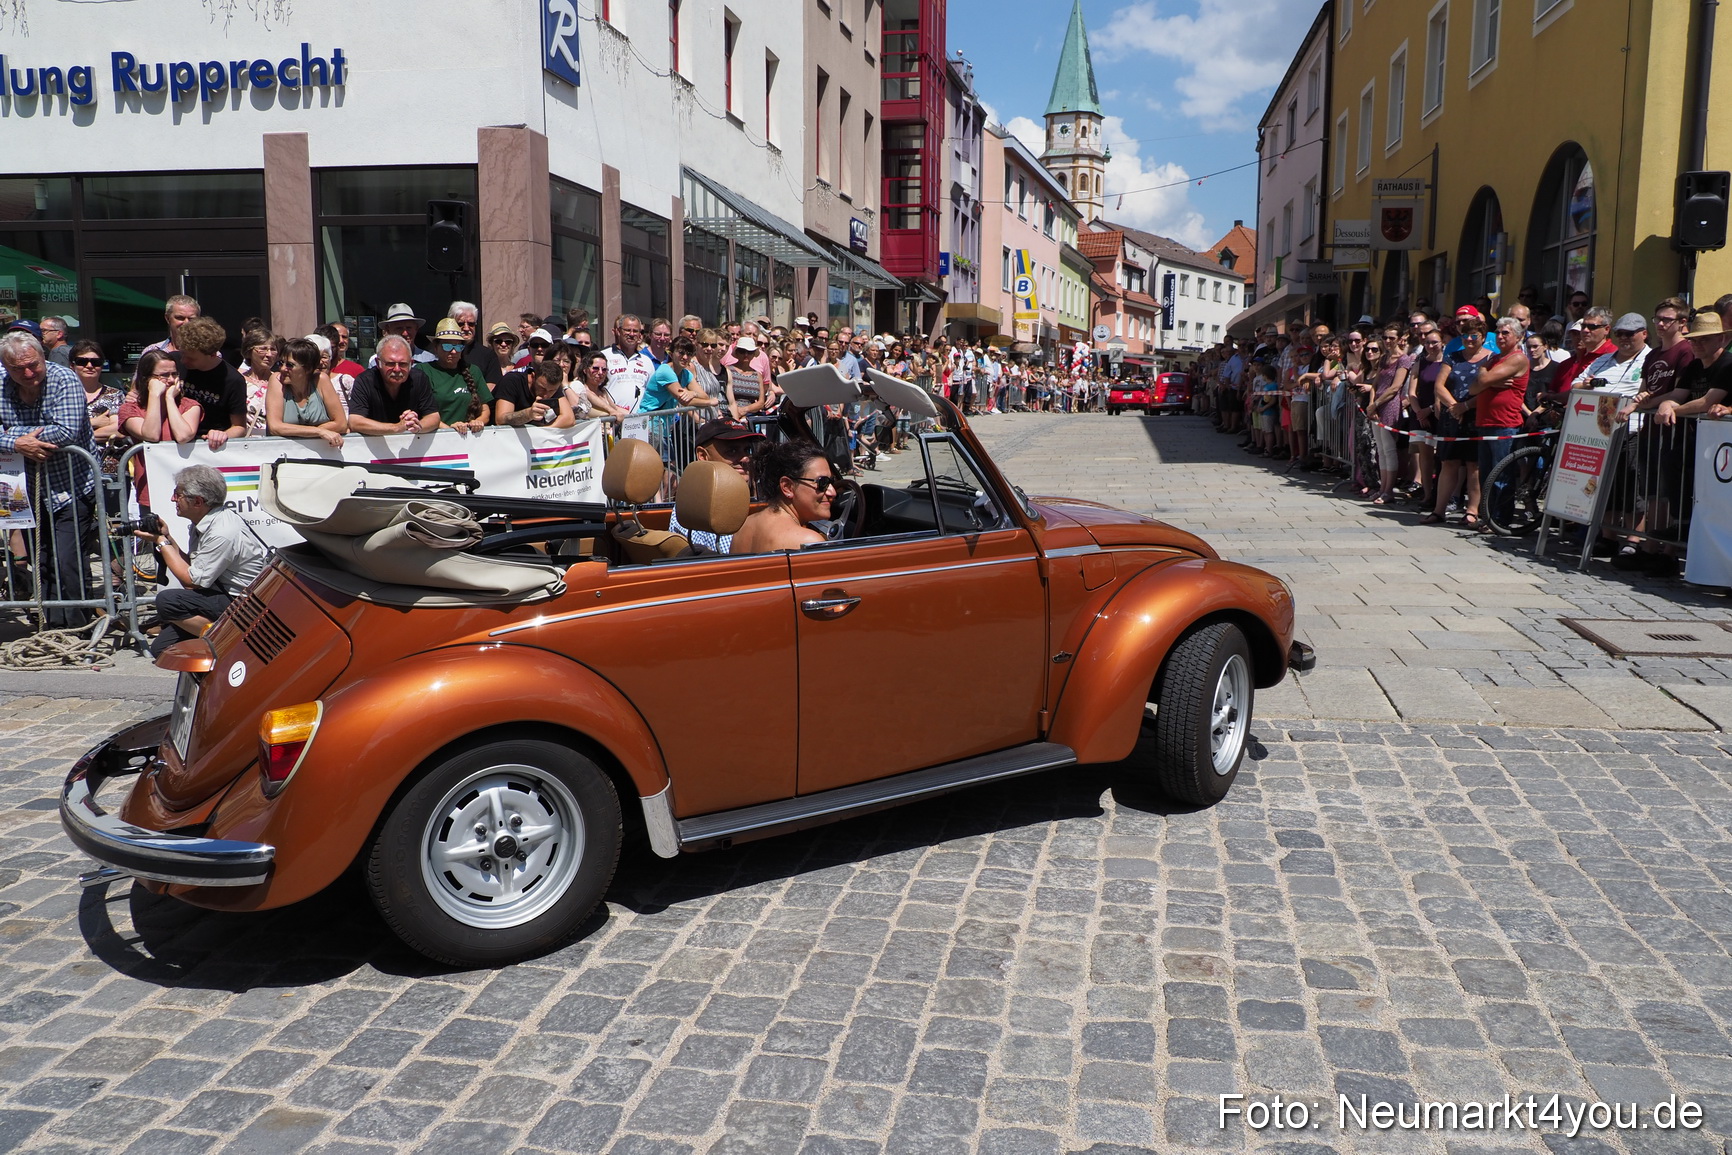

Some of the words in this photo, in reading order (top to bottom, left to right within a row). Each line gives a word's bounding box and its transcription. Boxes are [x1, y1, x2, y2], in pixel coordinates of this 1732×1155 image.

[111, 43, 346, 103] Rupprecht
[1377, 183, 1414, 192] RATHAUS
[1335, 228, 1364, 238] Dessous
[1017, 280, 1029, 292] B
[526, 466, 594, 490] NeuerMarkt
